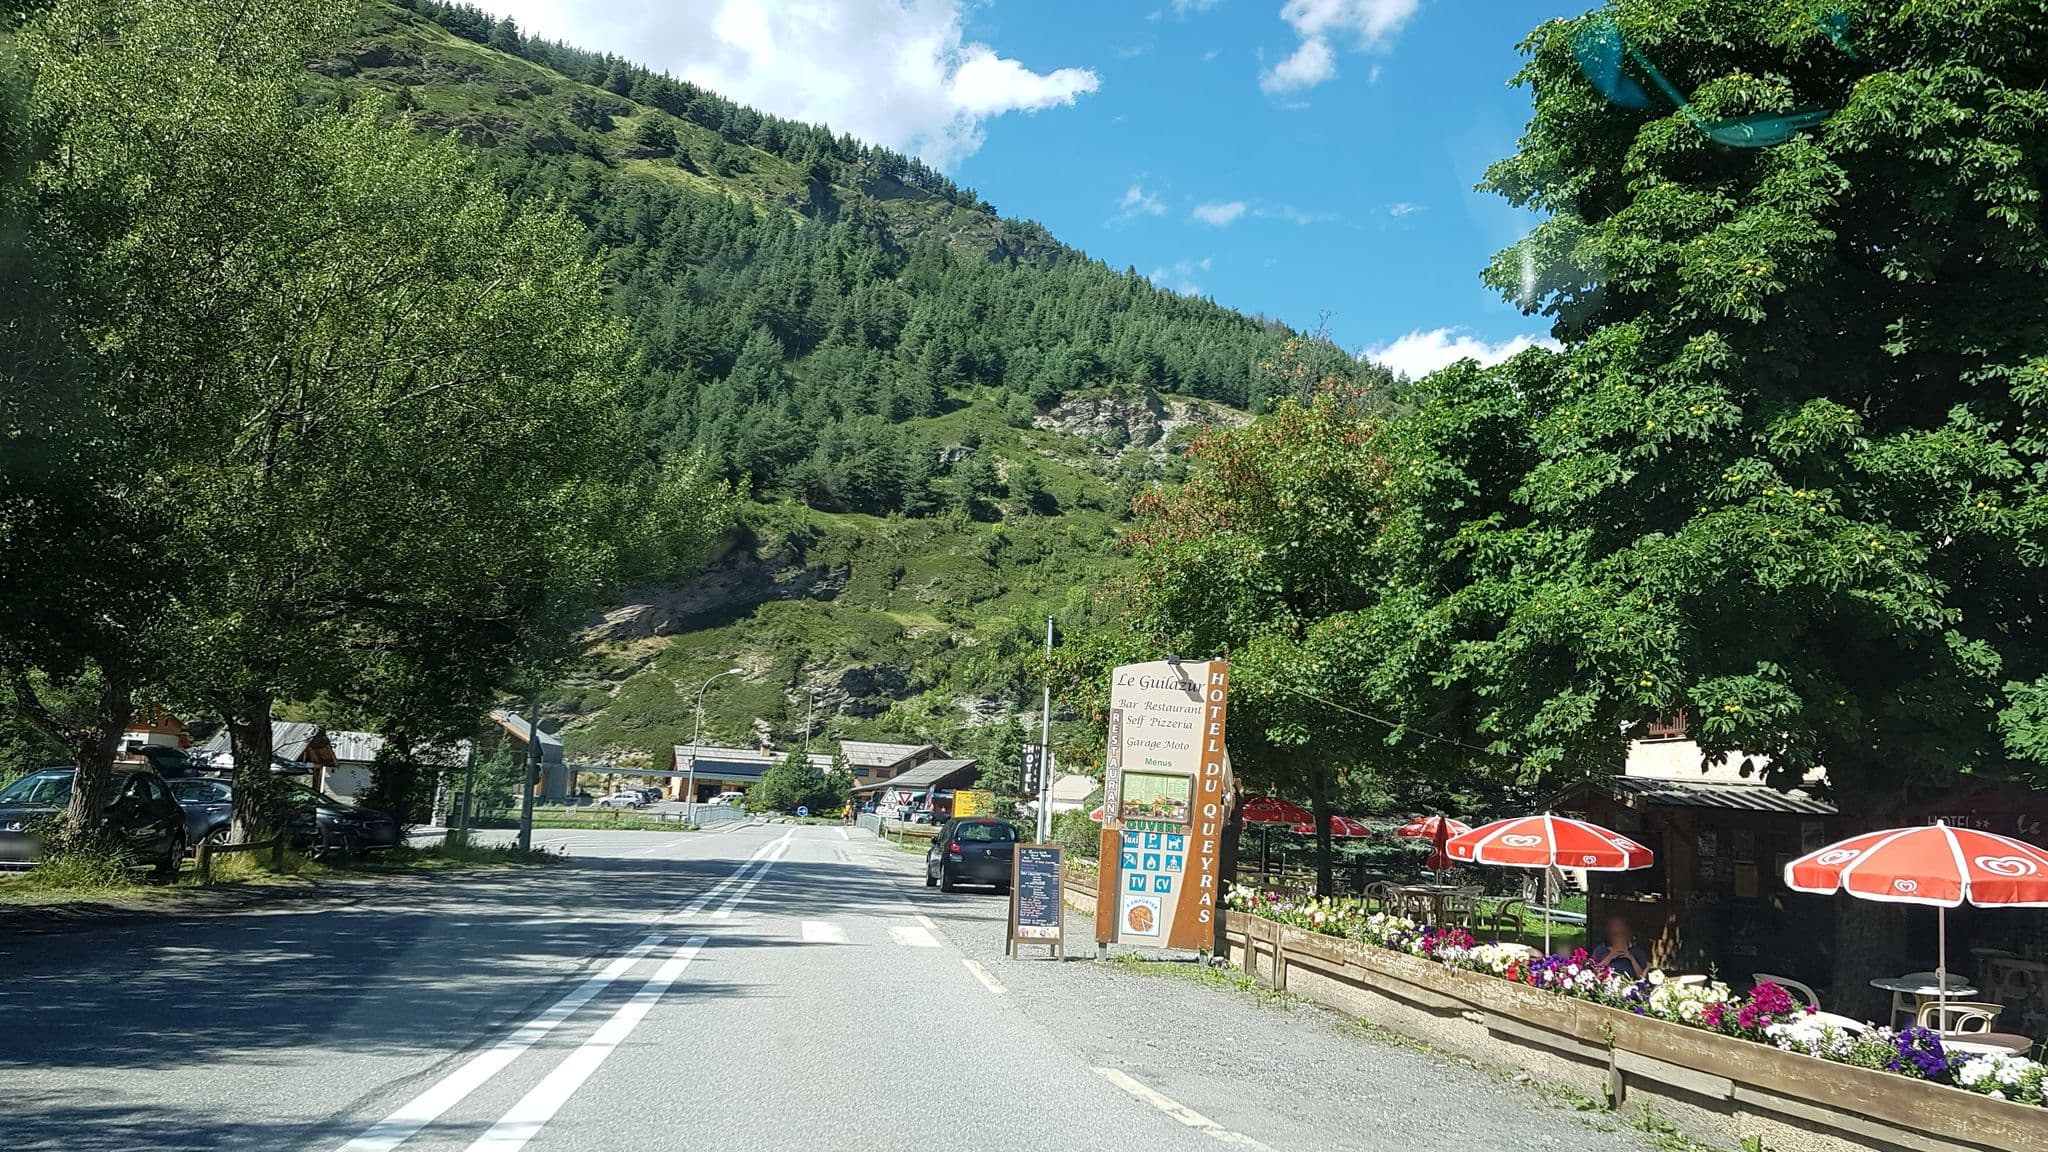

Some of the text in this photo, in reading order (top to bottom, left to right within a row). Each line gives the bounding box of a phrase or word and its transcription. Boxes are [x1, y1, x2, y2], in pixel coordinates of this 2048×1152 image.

[1117, 673, 1205, 693] Le Guilazur
[1118, 698, 1202, 715] Bar Restaurant
[1126, 714, 1193, 730] Self Pizzeria
[1126, 737, 1190, 751] Garage Moto
[1024, 744, 1035, 792] HOTEL
[1105, 713, 1120, 825] RESTAURANT
[1144, 757, 1172, 767] Menus
[1198, 672, 1224, 923] HOTEL DU QUEYRAS
[1126, 819, 1183, 833] OUVERT
[1131, 876, 1145, 888] TV
[1156, 878, 1169, 890] CV
